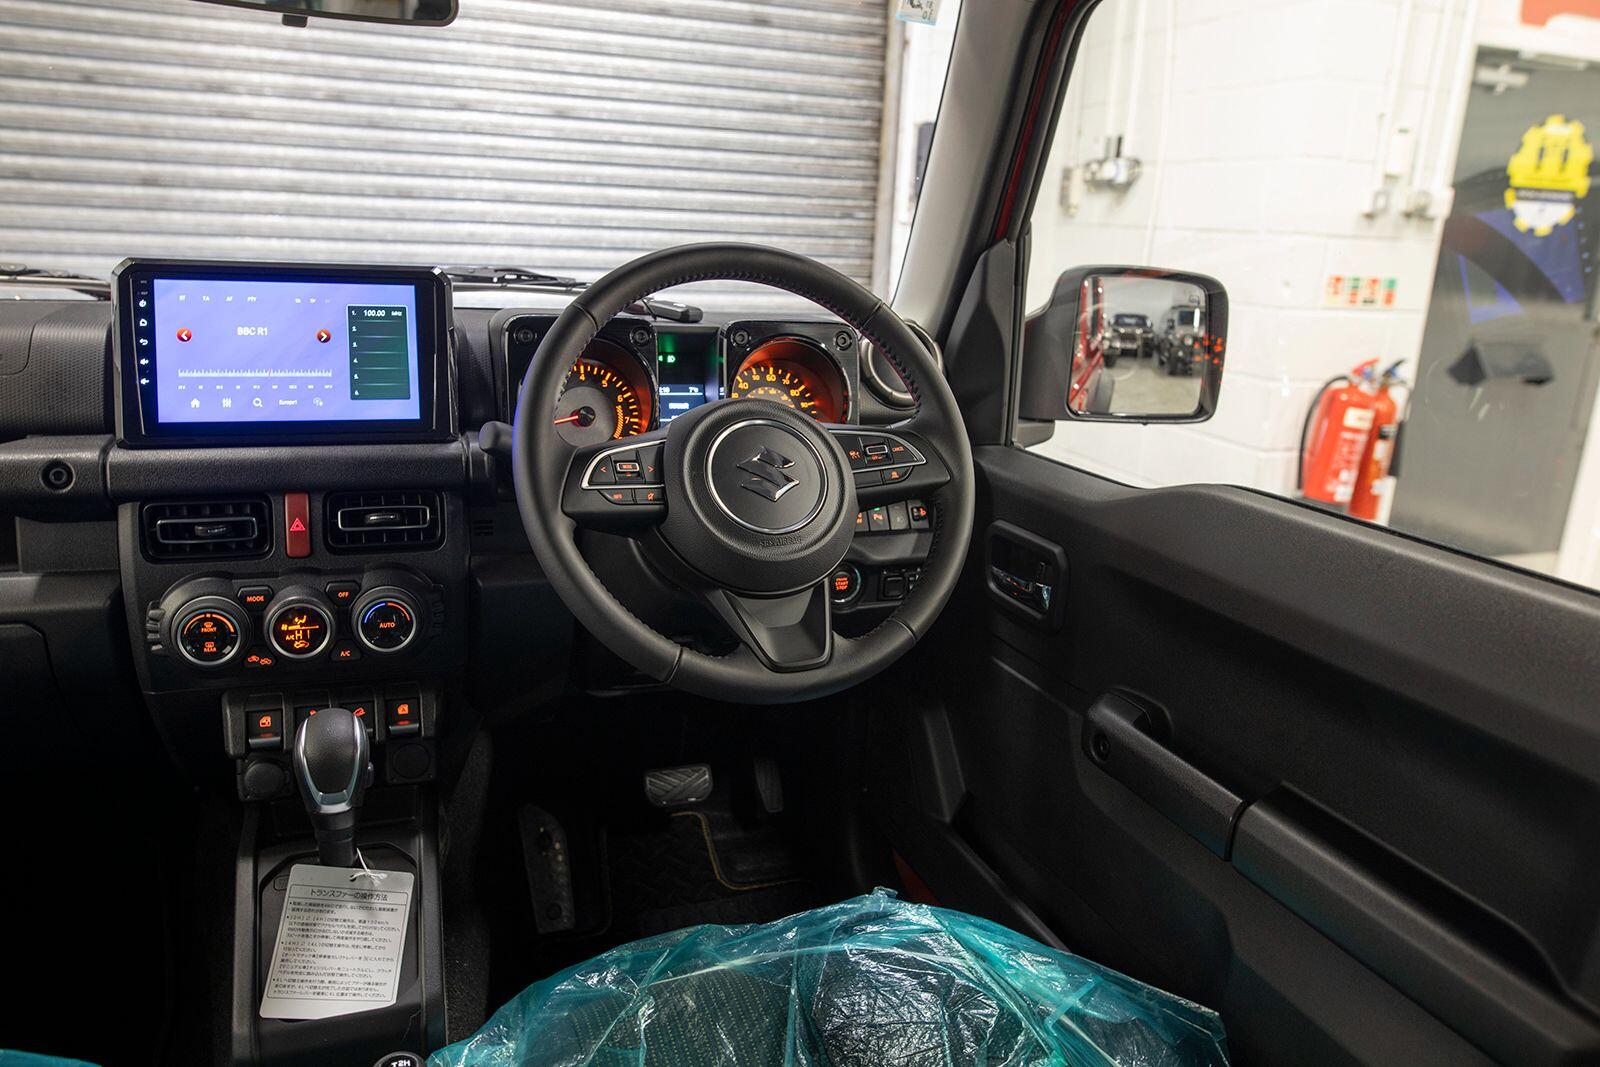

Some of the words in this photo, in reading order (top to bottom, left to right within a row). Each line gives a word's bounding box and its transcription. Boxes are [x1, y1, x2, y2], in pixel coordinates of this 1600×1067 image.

[363, 309, 387, 317] 100.00
[237, 326, 256, 336] BBC
[257, 326, 269, 336] R1
[765, 373, 777, 382] 60
[602, 380, 608, 388] 5
[738, 382, 749, 390] 40
[789, 388, 800, 397] 80
[617, 394, 623, 402] 6
[624, 416, 630, 424] 7
[246, 595, 265, 604] MODE
[379, 621, 396, 629] AUTO
[310, 888, 388, 902] トランスファーの操作方法
[398, 1059, 411, 1067] 2H
